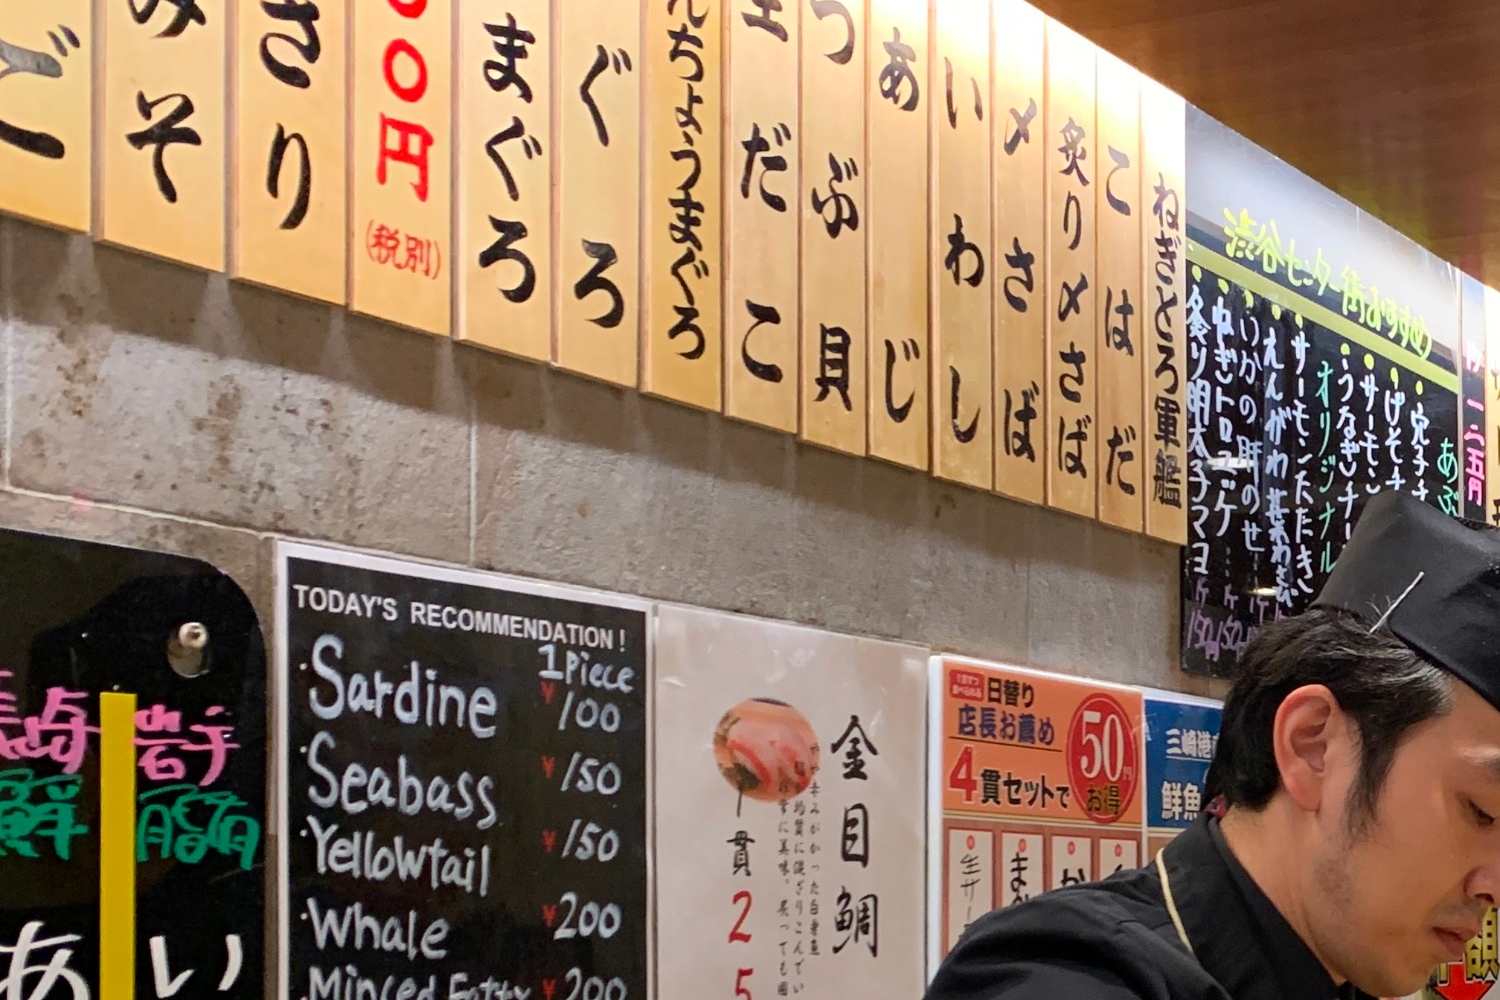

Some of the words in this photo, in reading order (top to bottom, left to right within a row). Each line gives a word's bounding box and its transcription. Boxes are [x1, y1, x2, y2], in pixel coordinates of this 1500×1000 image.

[479, 12, 543, 303] まぐろ
[573, 44, 632, 329] ぐろ
[810, 0, 860, 412] つぶ貝
[365, 219, 442, 281] (税別)
[878, 27, 922, 423] あじ
[944, 57, 985, 442] いわし
[1103, 144, 1138, 496] こはだ
[1152, 172, 1183, 510] ねぎとろ軍艦
[1186, 284, 1212, 575] 炙り明太子マヨ
[1291, 332, 1314, 593] サーモンたたき
[1316, 361, 1337, 573] オリジナル
[294, 584, 398, 621] TODAY'S
[309, 635, 497, 738] Sardine
[958, 704, 1055, 746] 店長お薦め
[987, 677, 1034, 708] 日替り
[131, 704, 240, 787] 岩手
[308, 731, 498, 829] Seabass
[1165, 728, 1220, 760] 三崎港
[831, 715, 879, 957] 金目鯛
[1086, 784, 1122, 815] お得
[1162, 781, 1202, 821] 鮮魚
[307, 815, 490, 897] Yellowtail
[960, 854, 981, 930] 生サー
[307, 898, 451, 960] Whale
